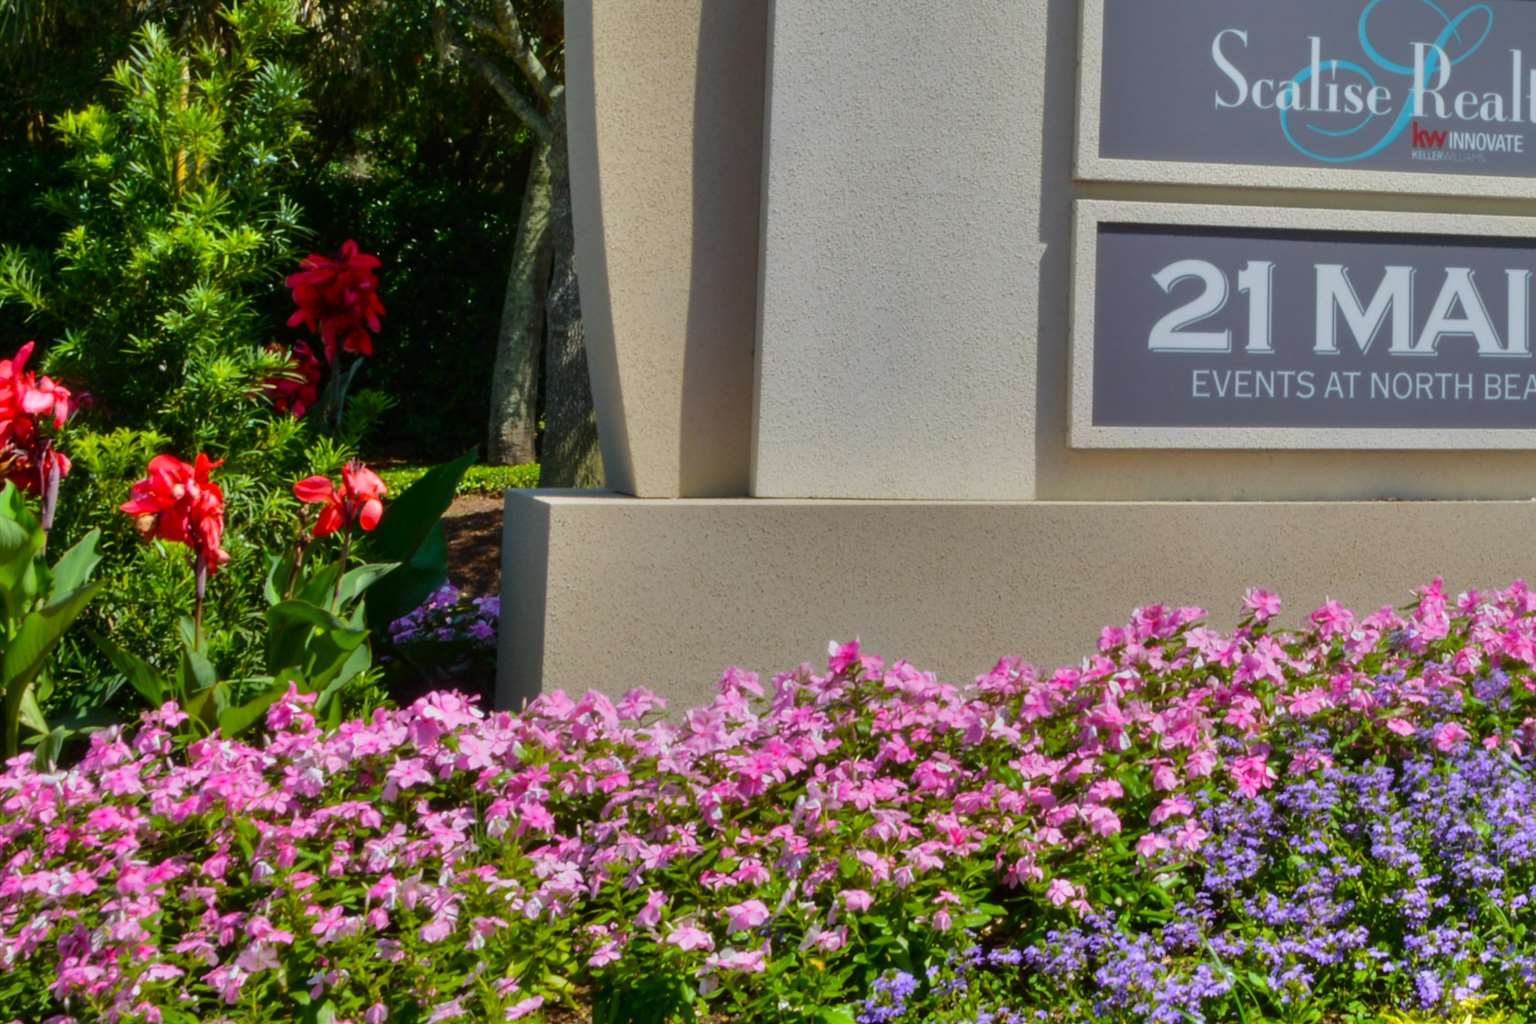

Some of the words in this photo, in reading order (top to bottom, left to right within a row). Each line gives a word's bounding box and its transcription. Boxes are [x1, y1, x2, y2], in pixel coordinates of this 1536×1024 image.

[1211, 29, 1391, 116] Scalise
[1449, 131, 1524, 153] INNOVATE
[1148, 259, 1276, 353] 21
[1192, 370, 1315, 399] EVENTS
[1324, 371, 1361, 399] AT
[1370, 372, 1473, 400] NORTH
